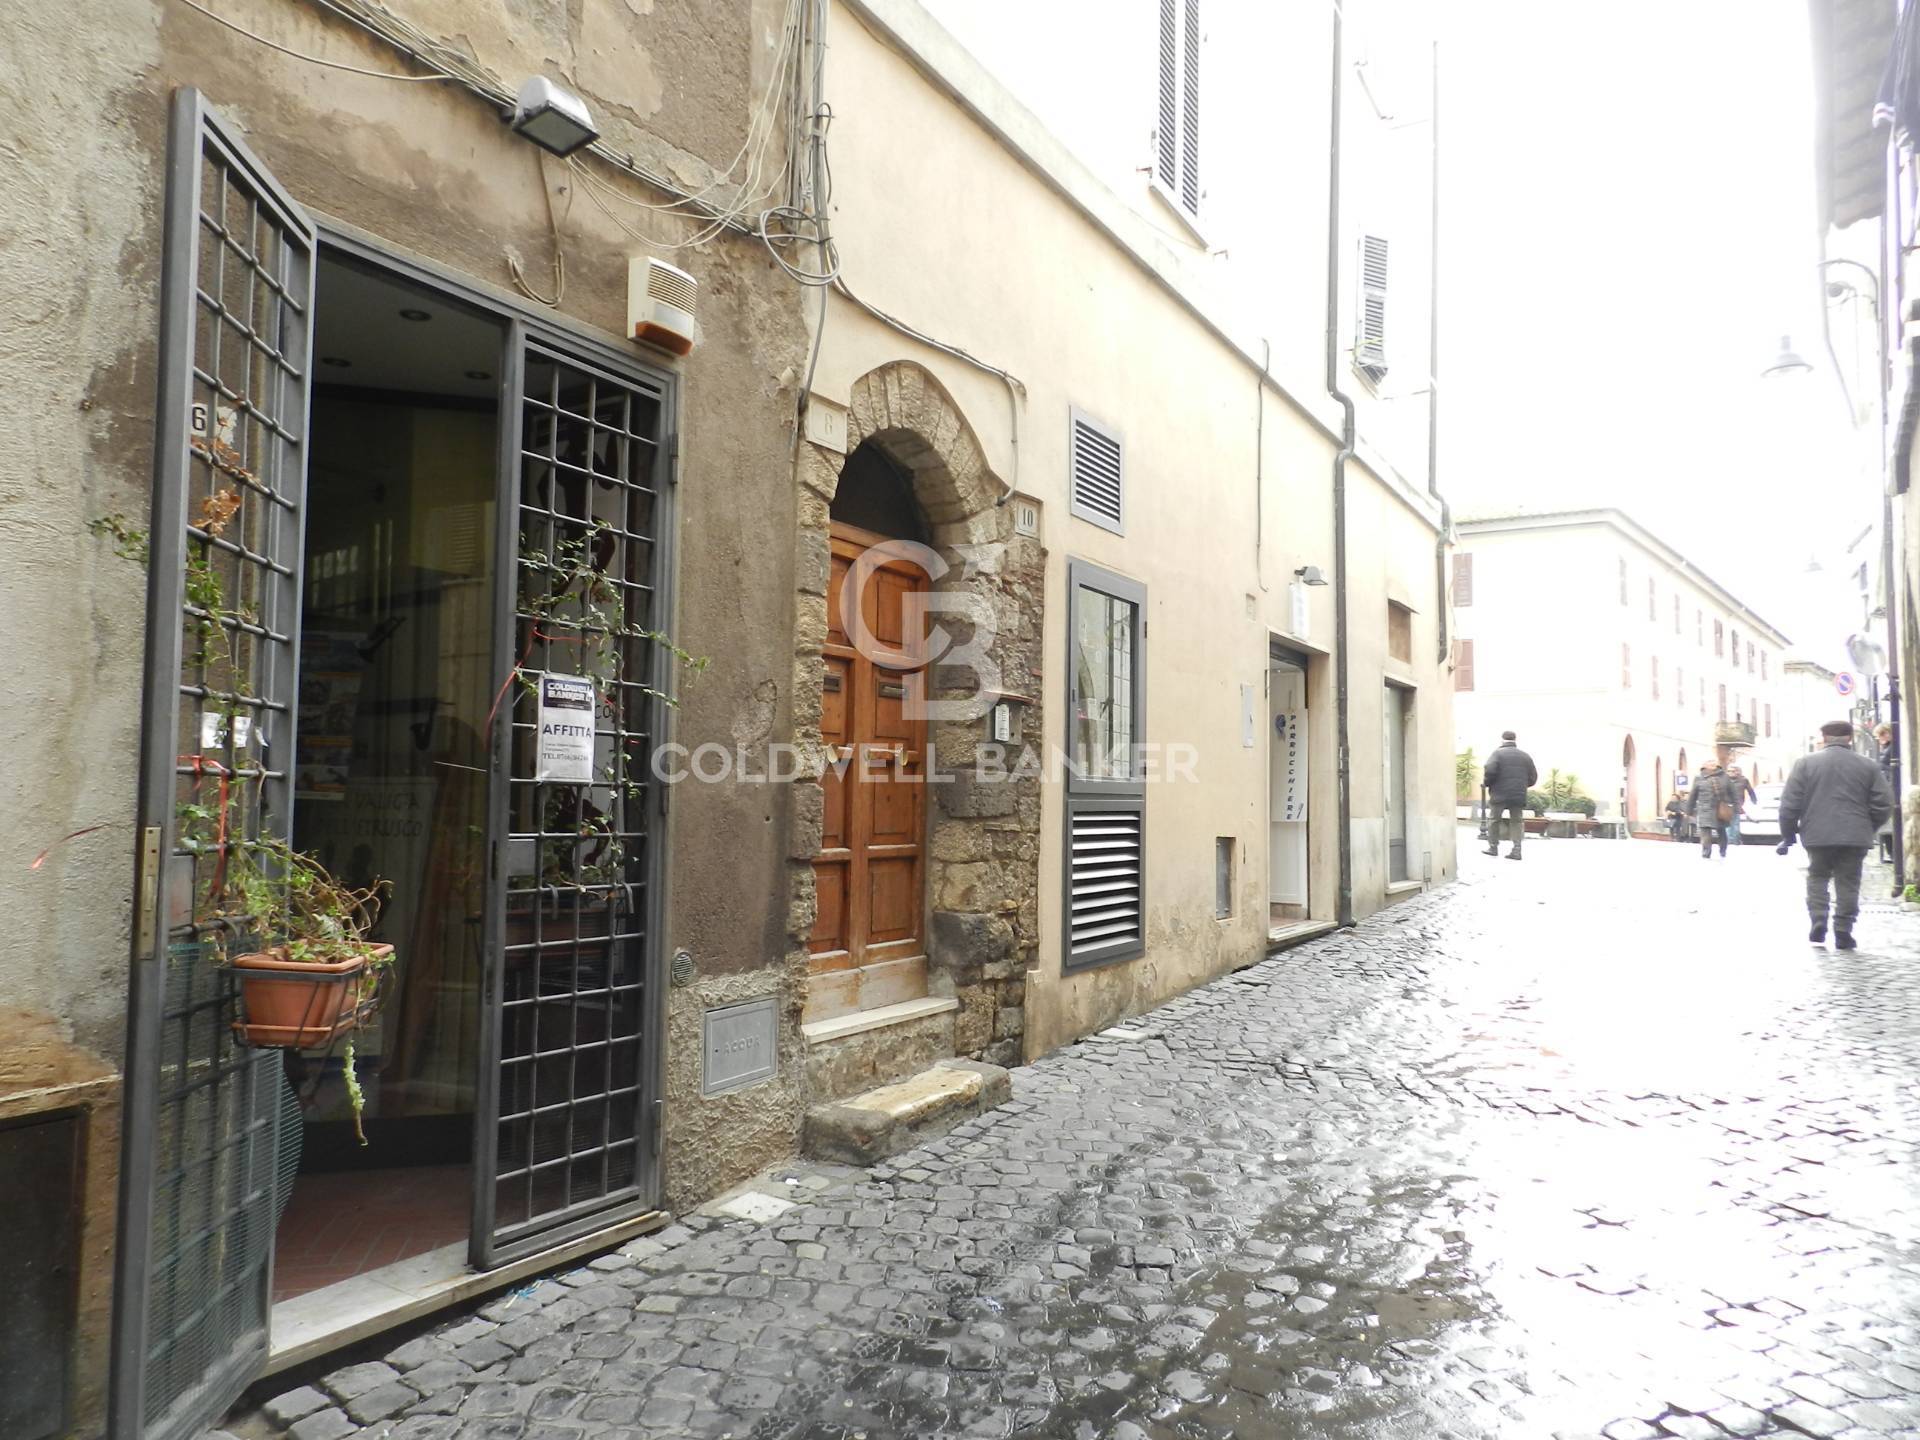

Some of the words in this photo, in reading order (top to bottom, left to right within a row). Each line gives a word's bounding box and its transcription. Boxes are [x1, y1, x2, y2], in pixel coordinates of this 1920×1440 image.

[1022, 507, 1034, 528] 10
[542, 723, 592, 738] AFFITTA
[1286, 714, 1297, 820] PARRUCCHIERE
